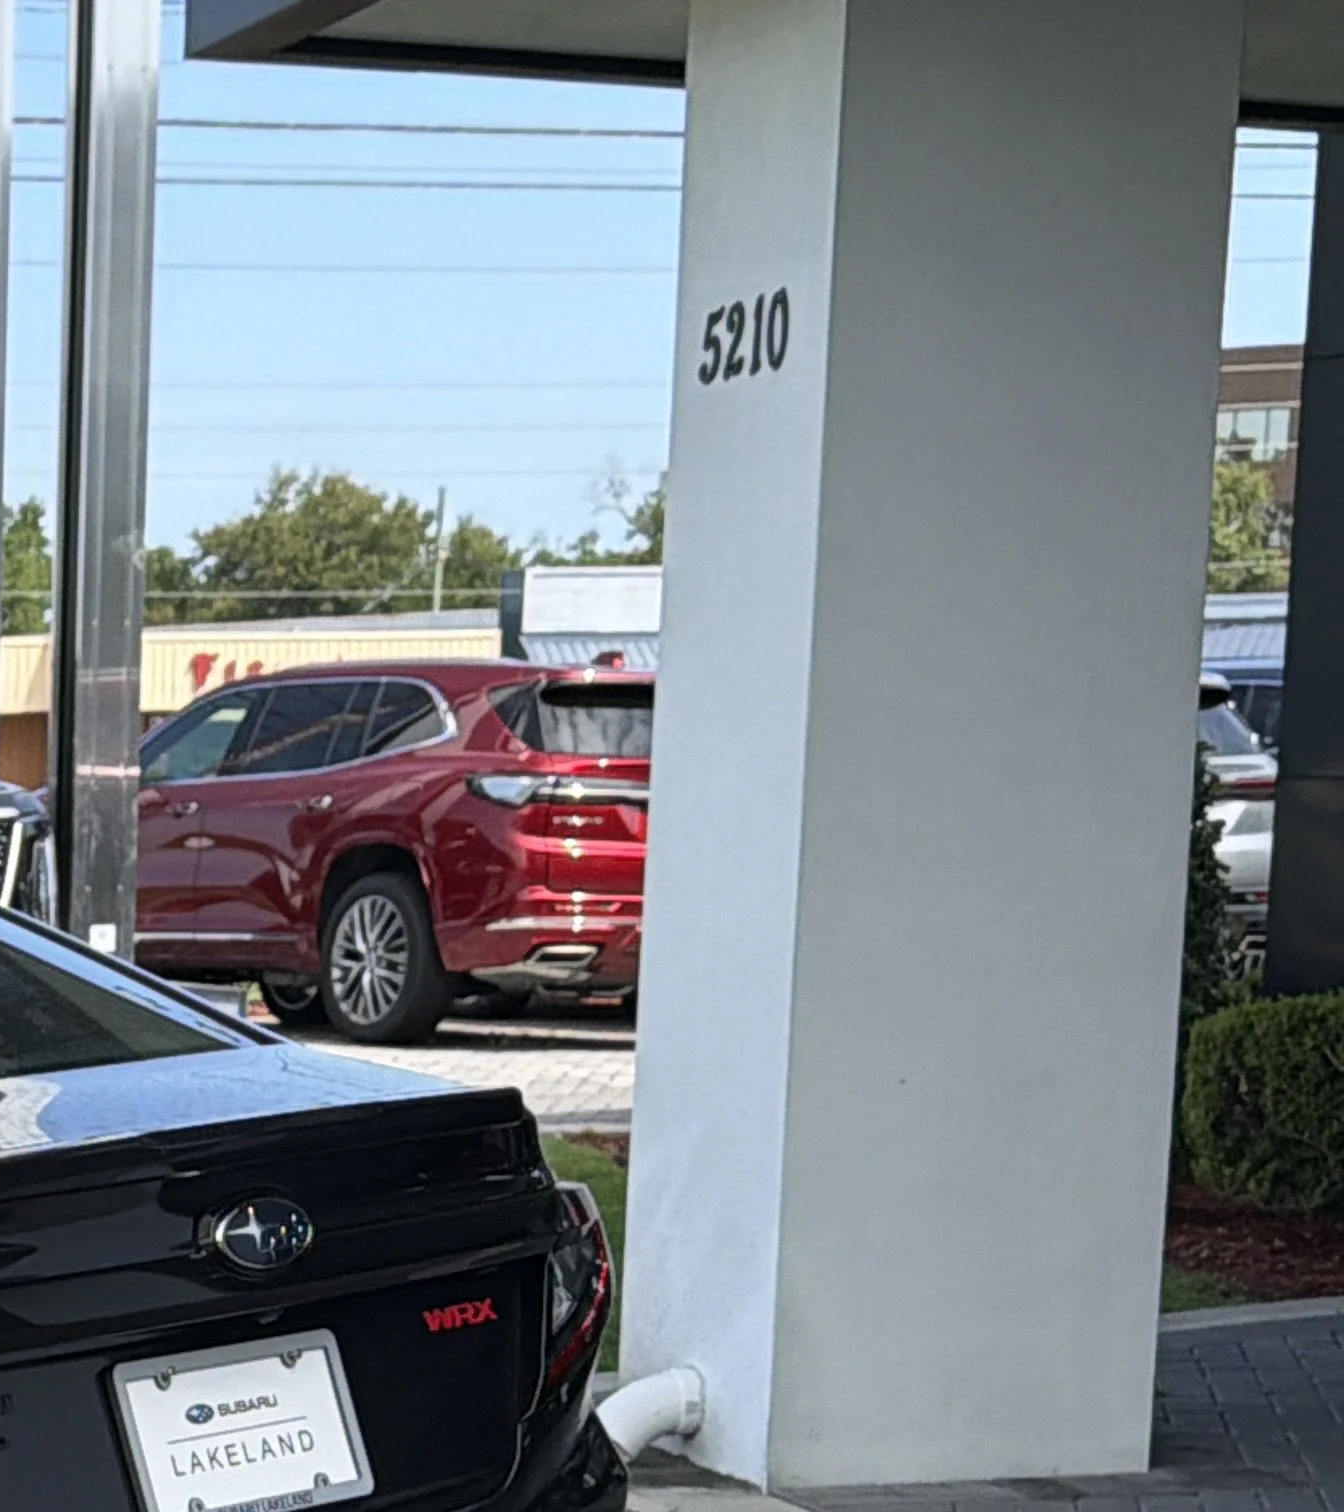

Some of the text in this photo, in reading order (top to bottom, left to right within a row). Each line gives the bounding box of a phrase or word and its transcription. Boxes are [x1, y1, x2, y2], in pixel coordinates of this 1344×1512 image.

[698, 285, 790, 386] 5210
[422, 1297, 499, 1333] WRX
[217, 1394, 279, 1418] SUBARU
[170, 1429, 315, 1478] LAKELAND
